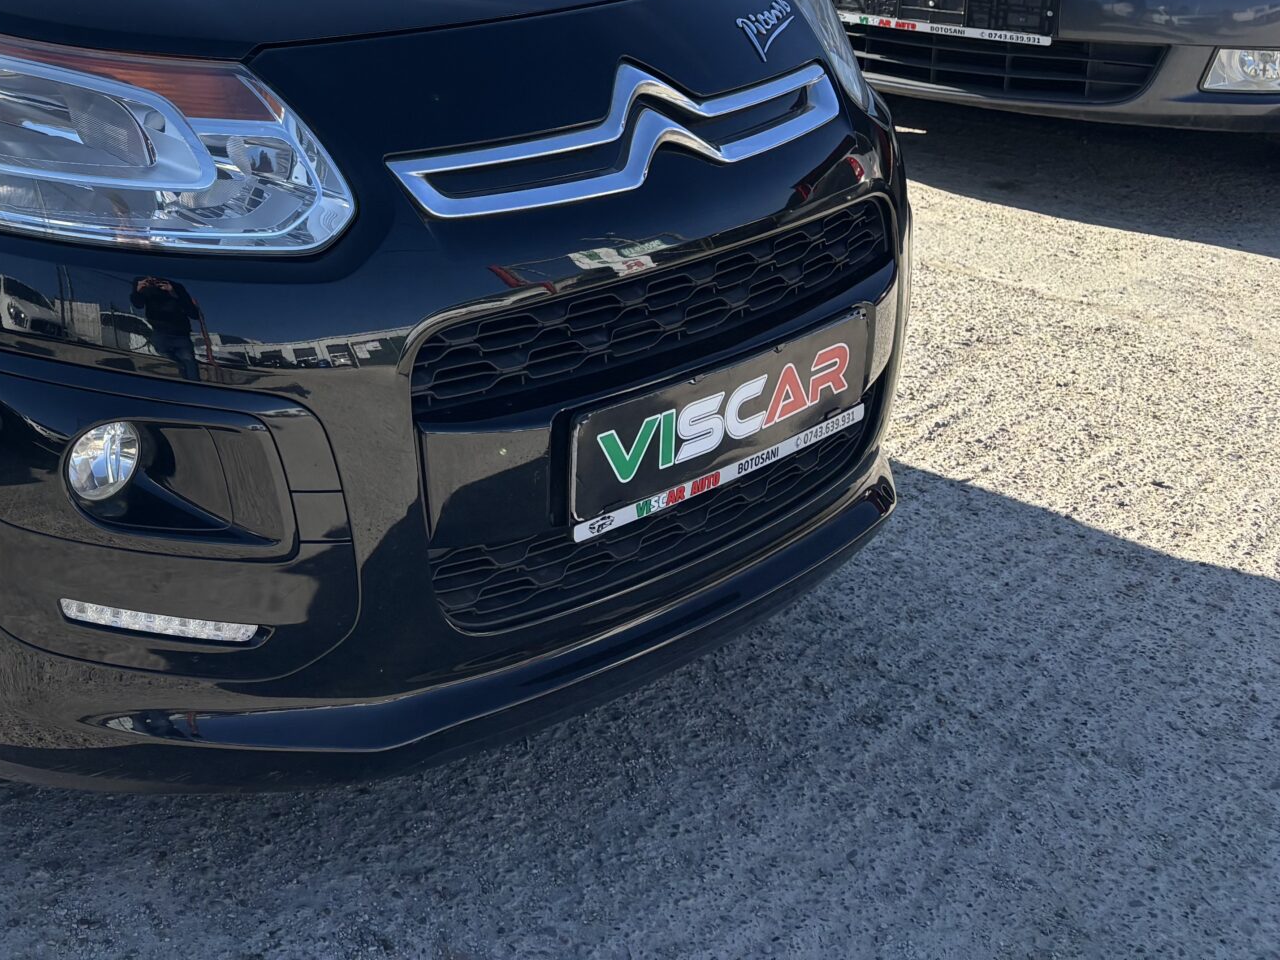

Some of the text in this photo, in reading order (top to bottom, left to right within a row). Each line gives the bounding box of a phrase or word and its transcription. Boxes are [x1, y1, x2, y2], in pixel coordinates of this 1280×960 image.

[597, 342, 850, 483] VISCAR
[635, 410, 855, 518] VISCAR AUTO BOTOSANI 0743.639.931
